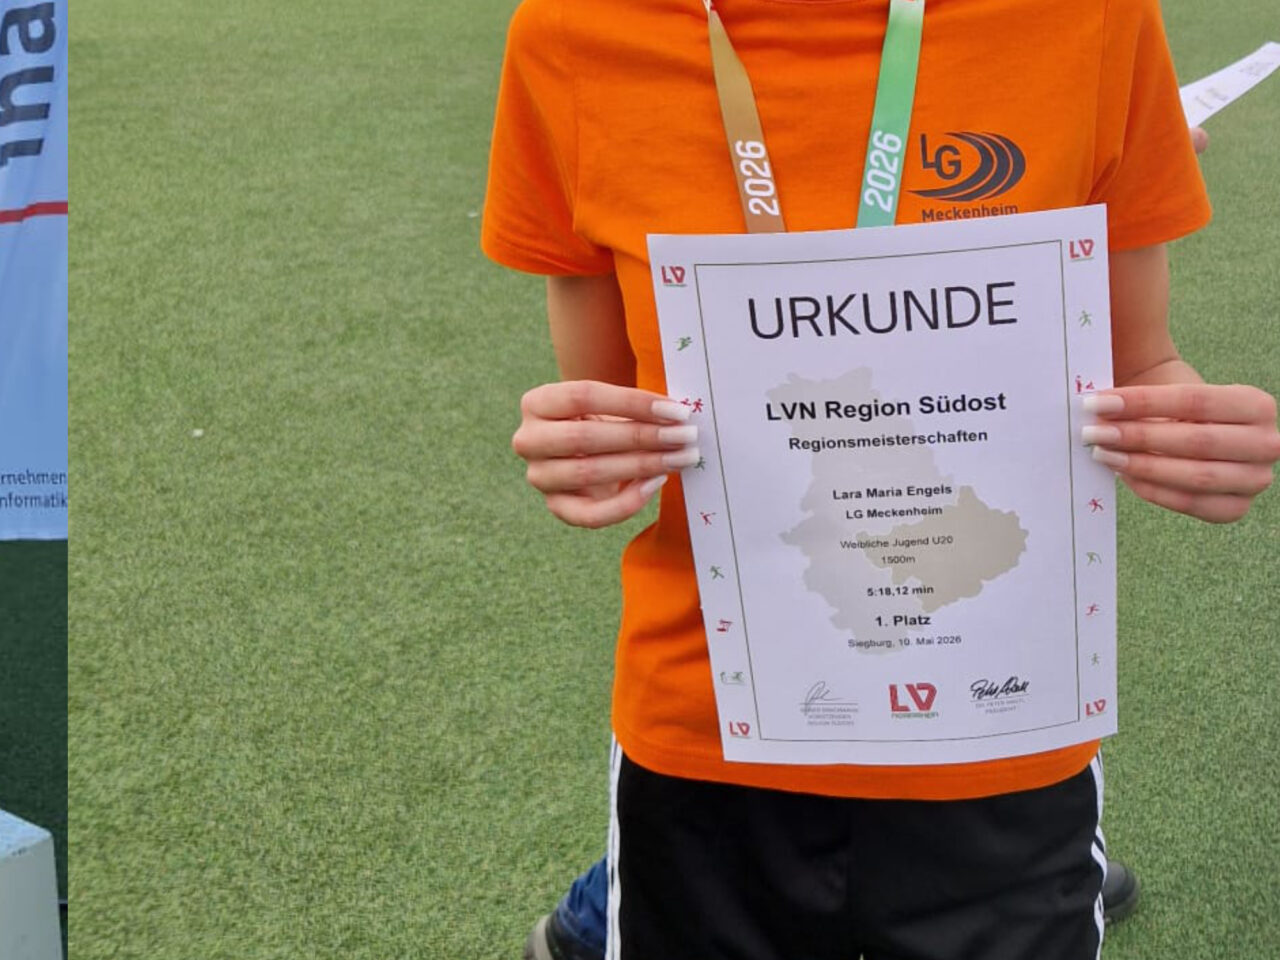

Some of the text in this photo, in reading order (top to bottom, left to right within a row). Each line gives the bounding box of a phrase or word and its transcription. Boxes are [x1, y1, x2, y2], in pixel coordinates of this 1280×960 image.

[920, 133, 961, 180] LG
[736, 140, 779, 216] 2026
[865, 131, 902, 213] 2026
[922, 203, 1019, 222] Meckenheim
[748, 281, 1018, 340] URKUNDE
[766, 392, 1007, 422] LVN Region Südost
[789, 429, 988, 453] Regionsmeisterschaften
[832, 484, 953, 501] Lara Maria Engels
[846, 506, 943, 520] LG Meckenheim
[840, 535, 954, 550] Weibliche Jugend U20
[881, 555, 916, 565] 1500m
[866, 585, 935, 597] 5:18,12 min
[875, 614, 932, 627] 1. Platz
[847, 635, 962, 650] Siegburg, 10. Mai 2026
